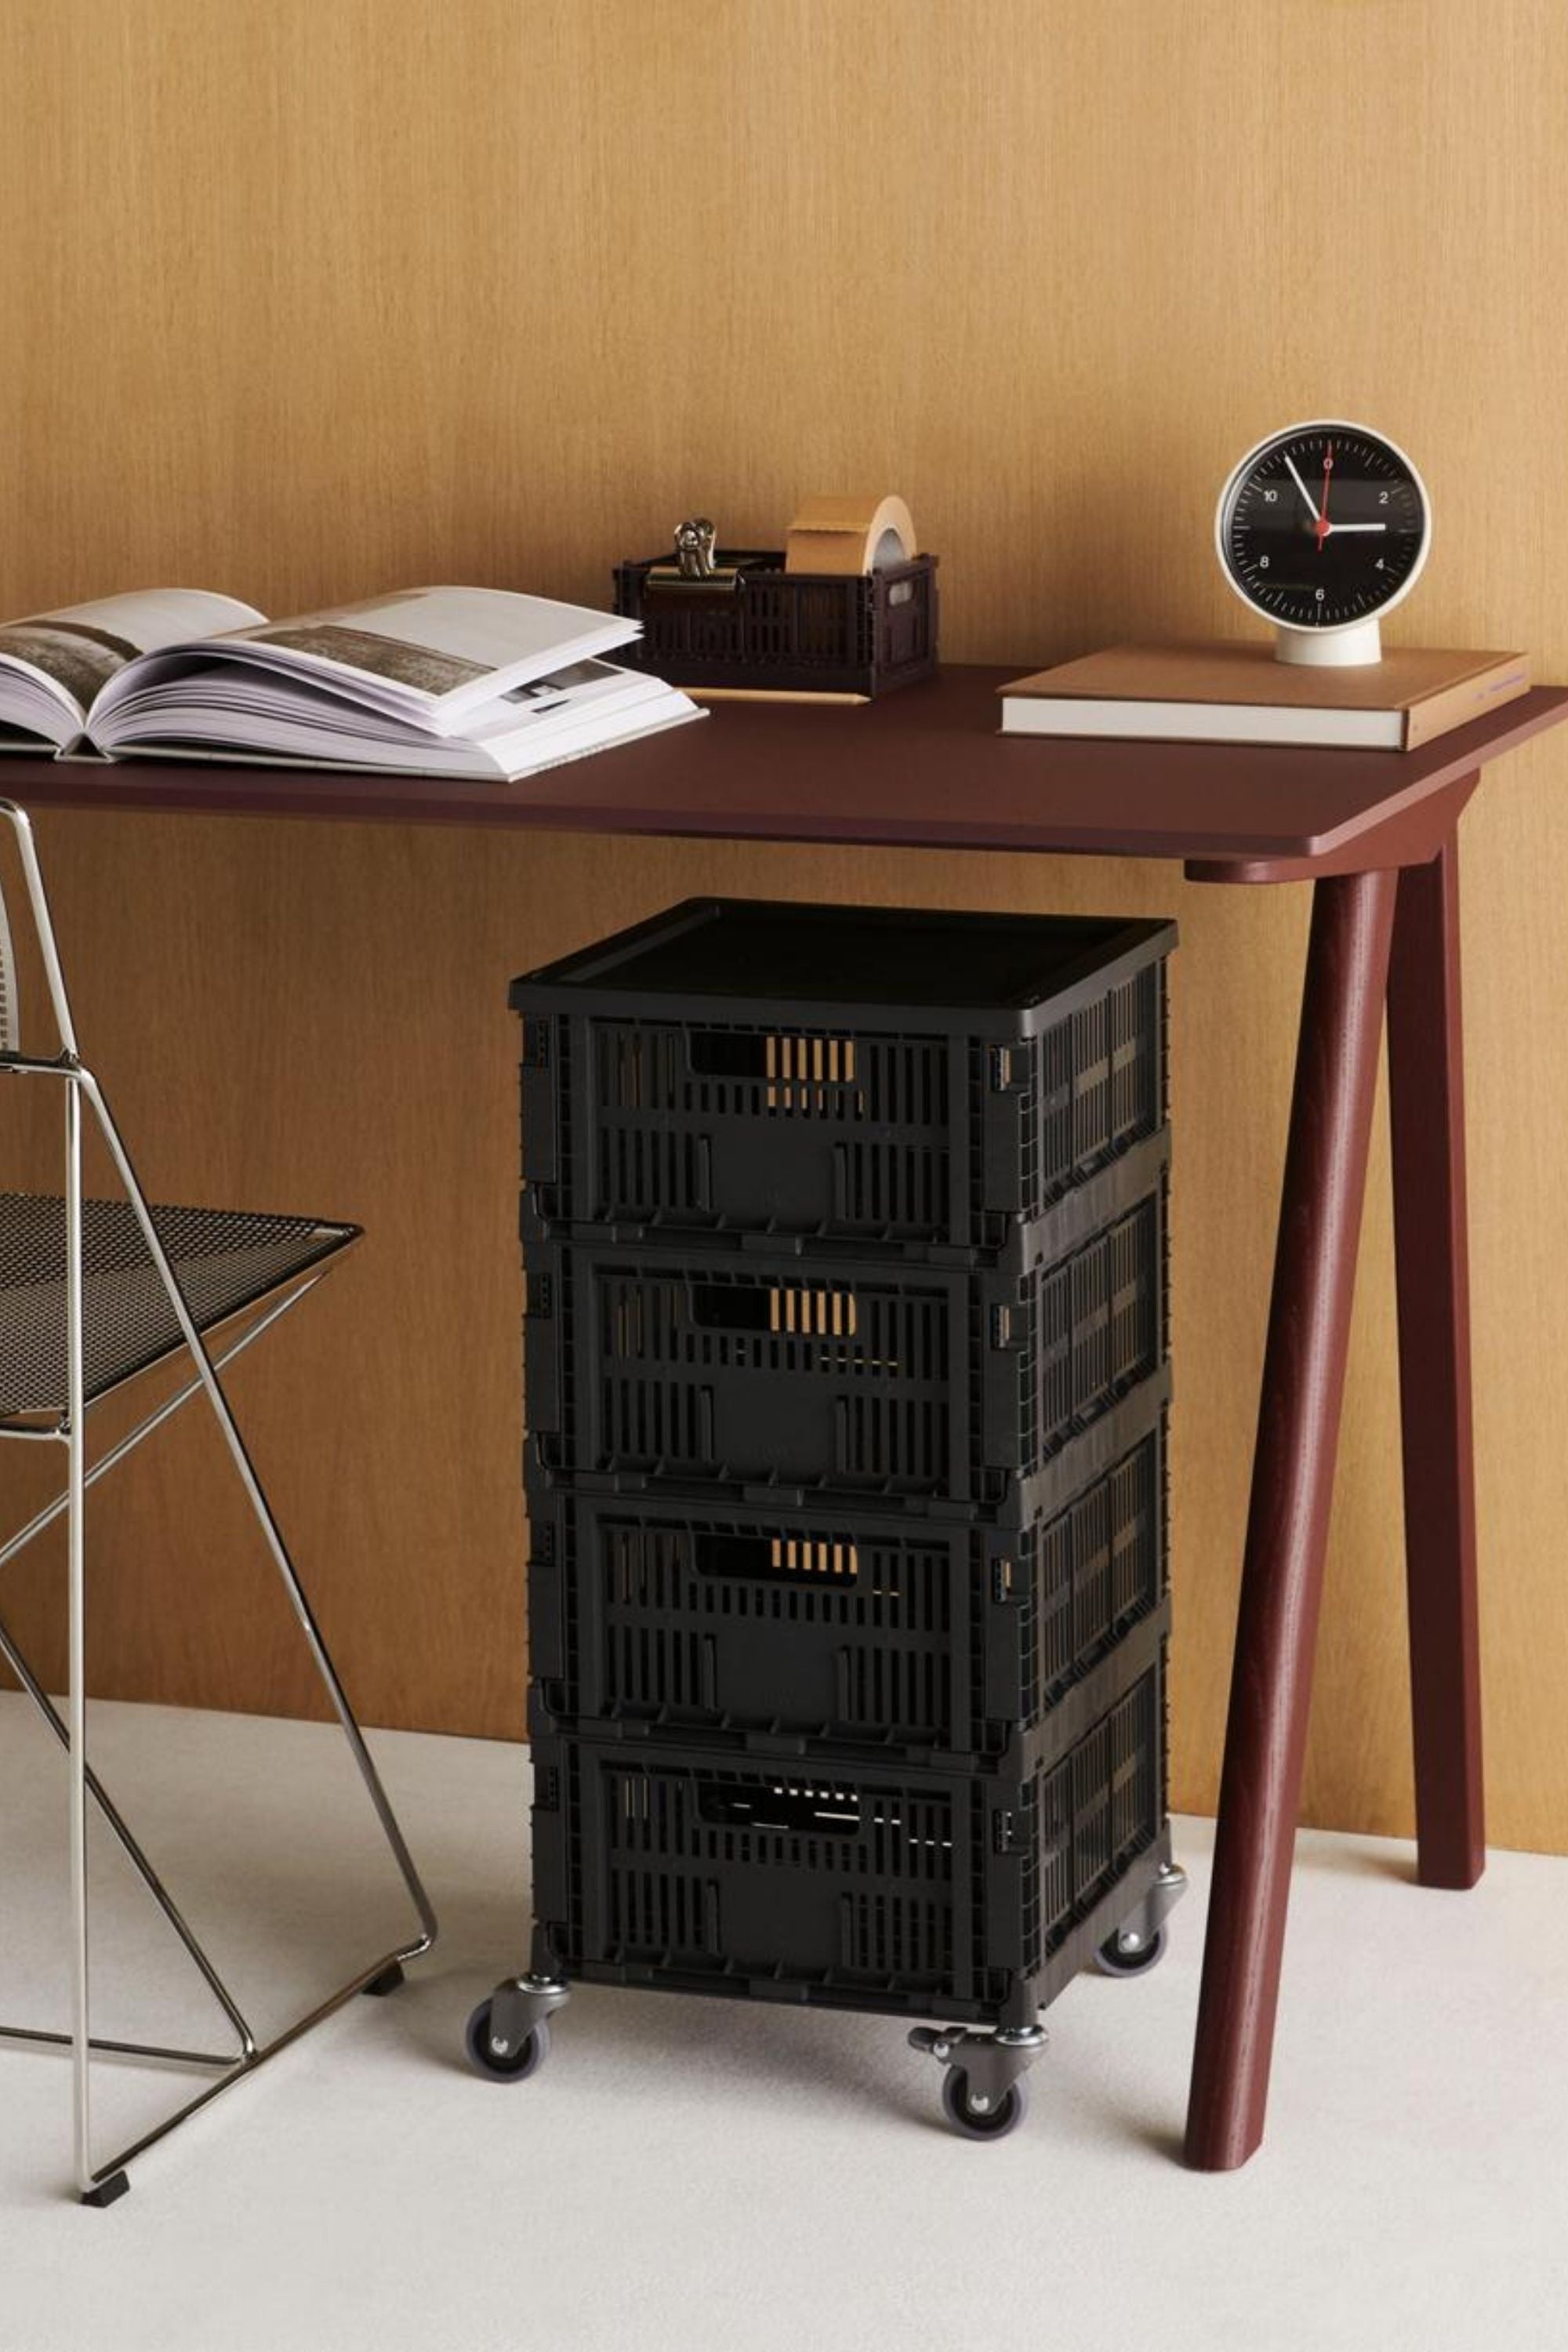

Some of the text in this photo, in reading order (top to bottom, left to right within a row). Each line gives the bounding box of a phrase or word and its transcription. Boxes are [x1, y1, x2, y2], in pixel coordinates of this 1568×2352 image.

[1263, 489, 1278, 503] 10
[1378, 492, 1389, 504] 2
[1259, 555, 1269, 568] 8
[1375, 558, 1385, 569] 4
[1315, 589, 1325, 601] 6
